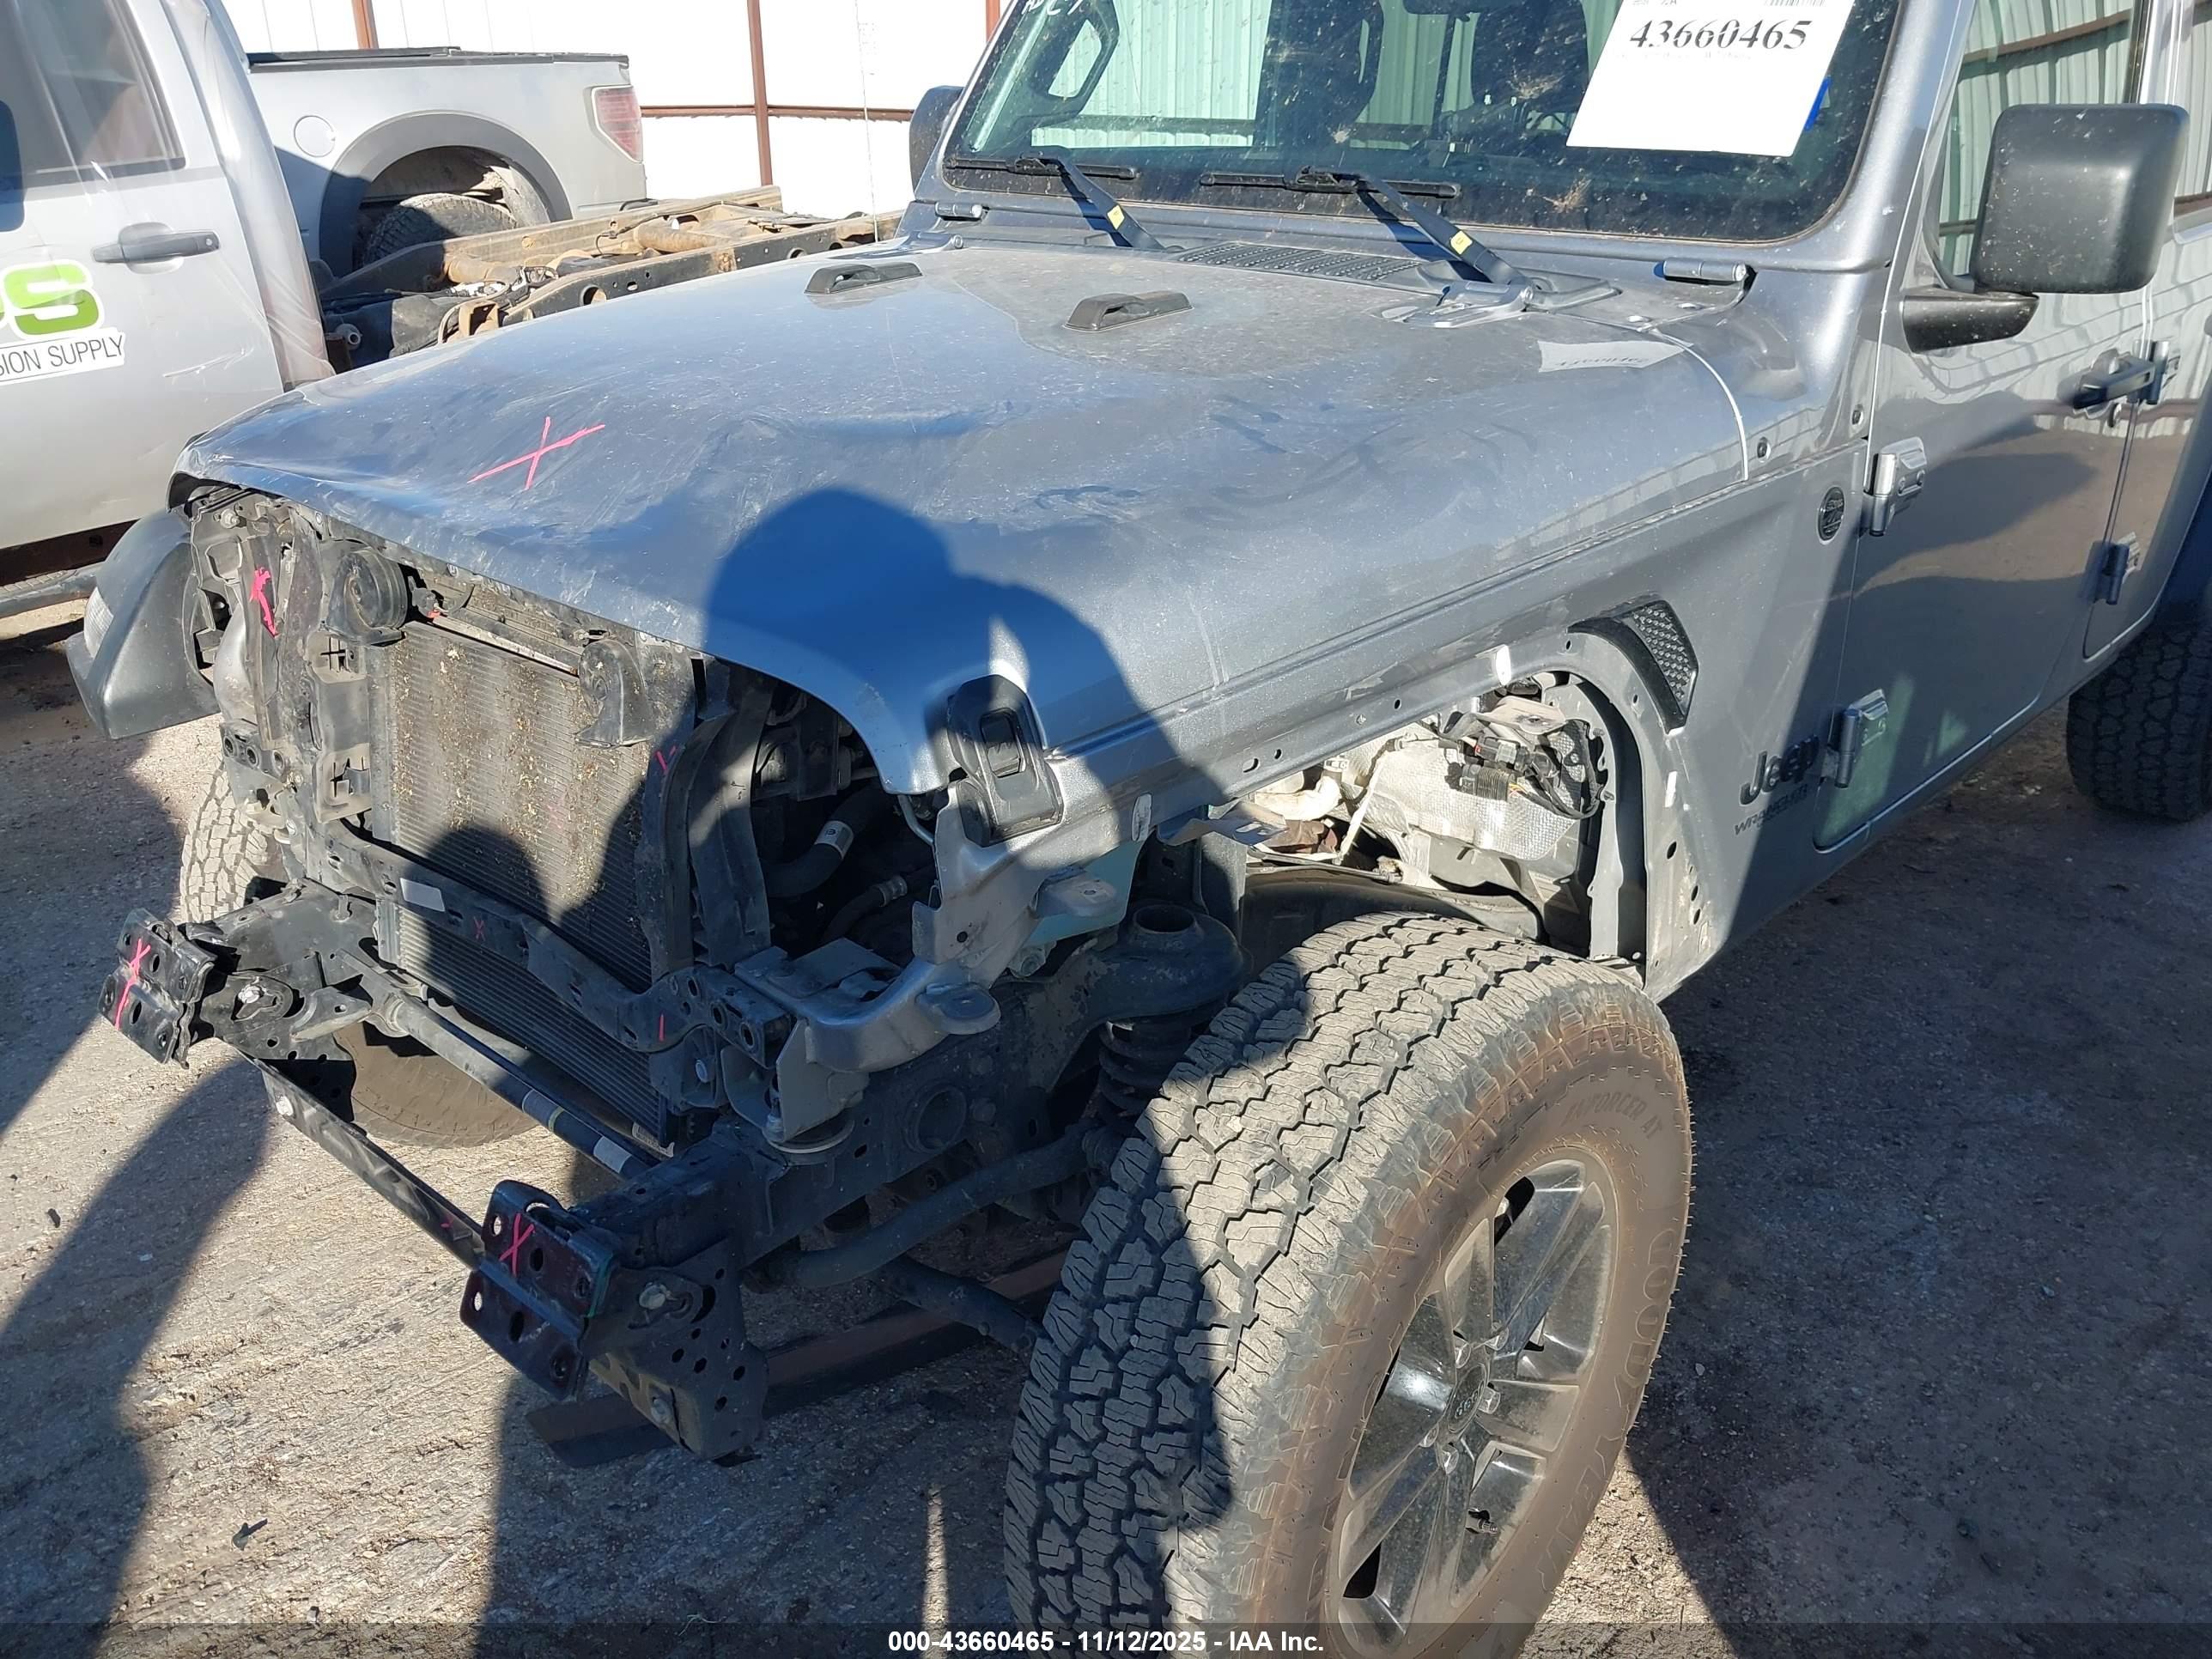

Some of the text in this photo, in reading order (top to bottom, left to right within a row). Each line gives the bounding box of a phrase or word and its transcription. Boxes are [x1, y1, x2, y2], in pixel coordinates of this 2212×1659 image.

[1629, 19, 1814, 50] 43660465
[47, 335, 123, 368] SUPPLY
[1739, 735, 1820, 805] Jeep
